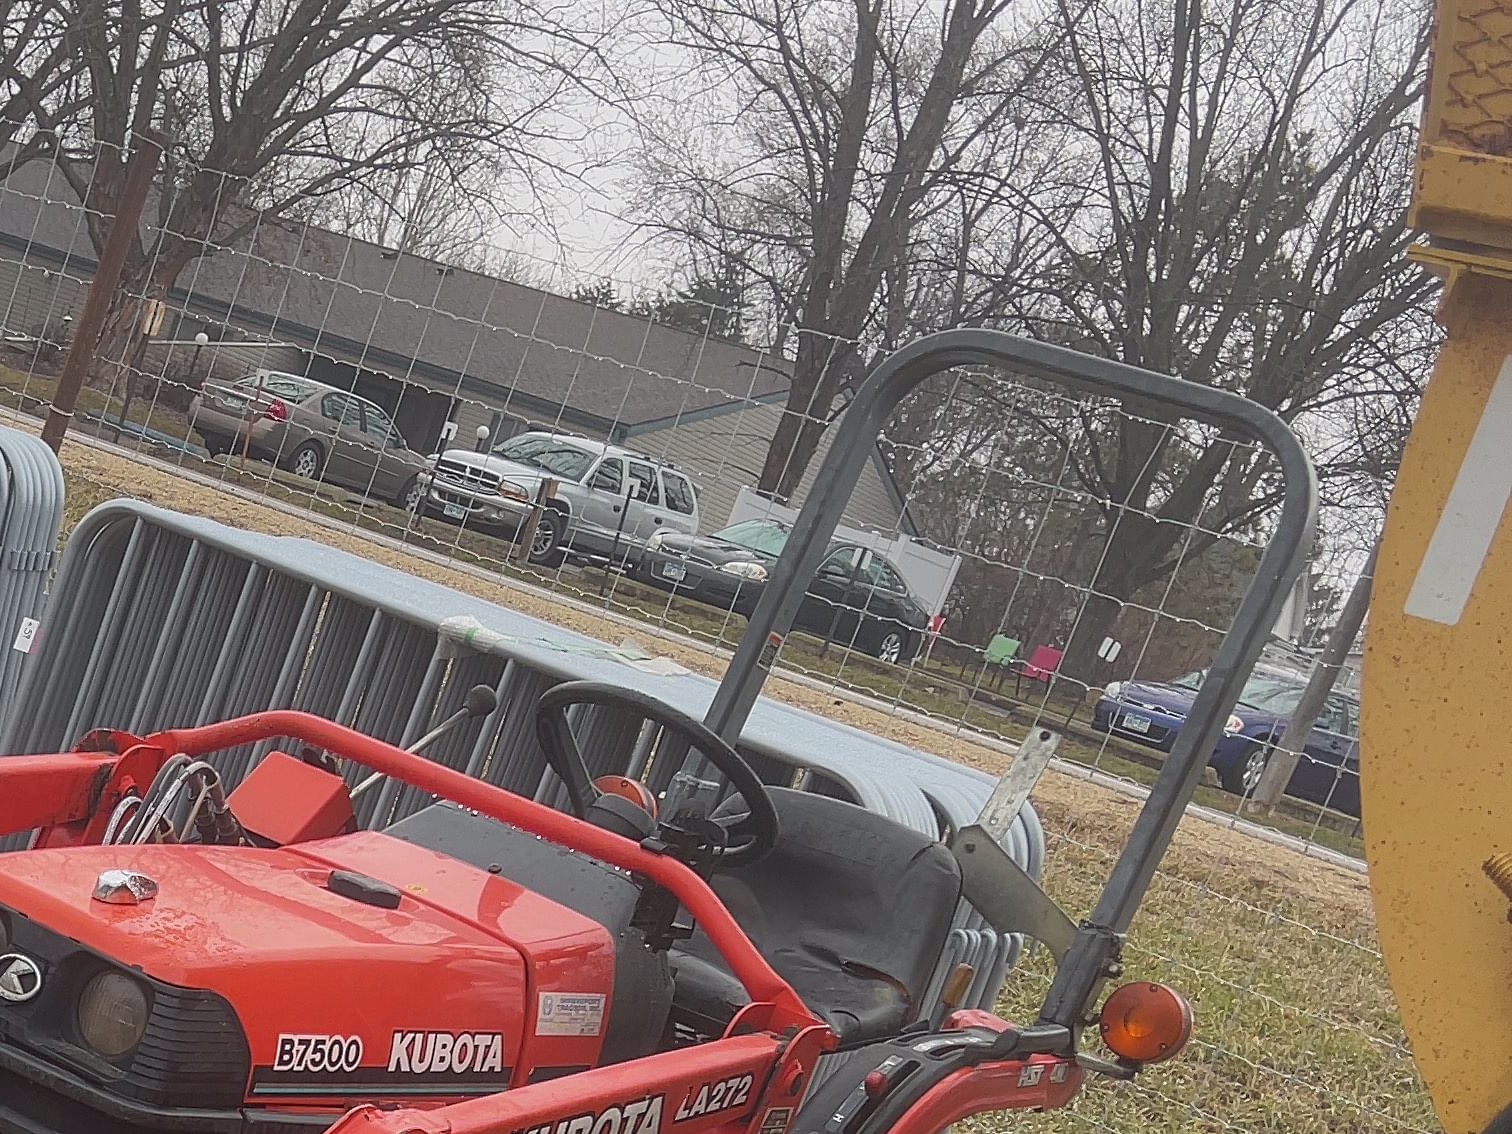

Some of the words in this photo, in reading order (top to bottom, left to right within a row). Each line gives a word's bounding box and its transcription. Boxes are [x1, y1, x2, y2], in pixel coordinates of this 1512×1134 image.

[274, 1033, 363, 1072] B7500
[387, 1031, 503, 1074] KUBOTA
[674, 1074, 754, 1121] LA272
